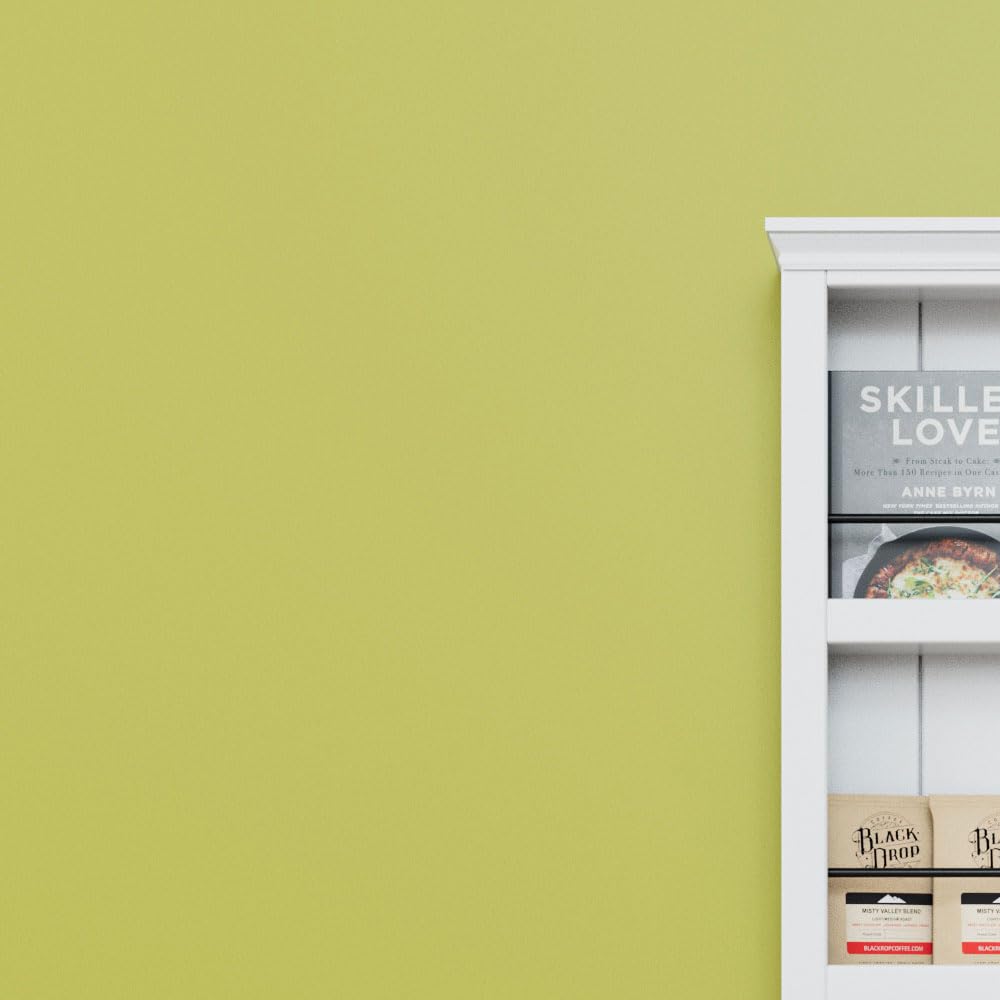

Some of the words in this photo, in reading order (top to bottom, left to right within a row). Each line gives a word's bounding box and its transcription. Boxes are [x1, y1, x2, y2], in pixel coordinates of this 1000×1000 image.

[892, 418, 1000, 446] LOVE
[906, 457, 927, 465] From
[955, 457, 963, 465] to
[854, 468, 875, 478] More
[878, 468, 898, 478] Than
[965, 468, 982, 478] One
[902, 486, 946, 498] ANNE
[952, 486, 996, 498] BYRN
[852, 828, 920, 855] BLACK
[873, 845, 920, 868] DROP
